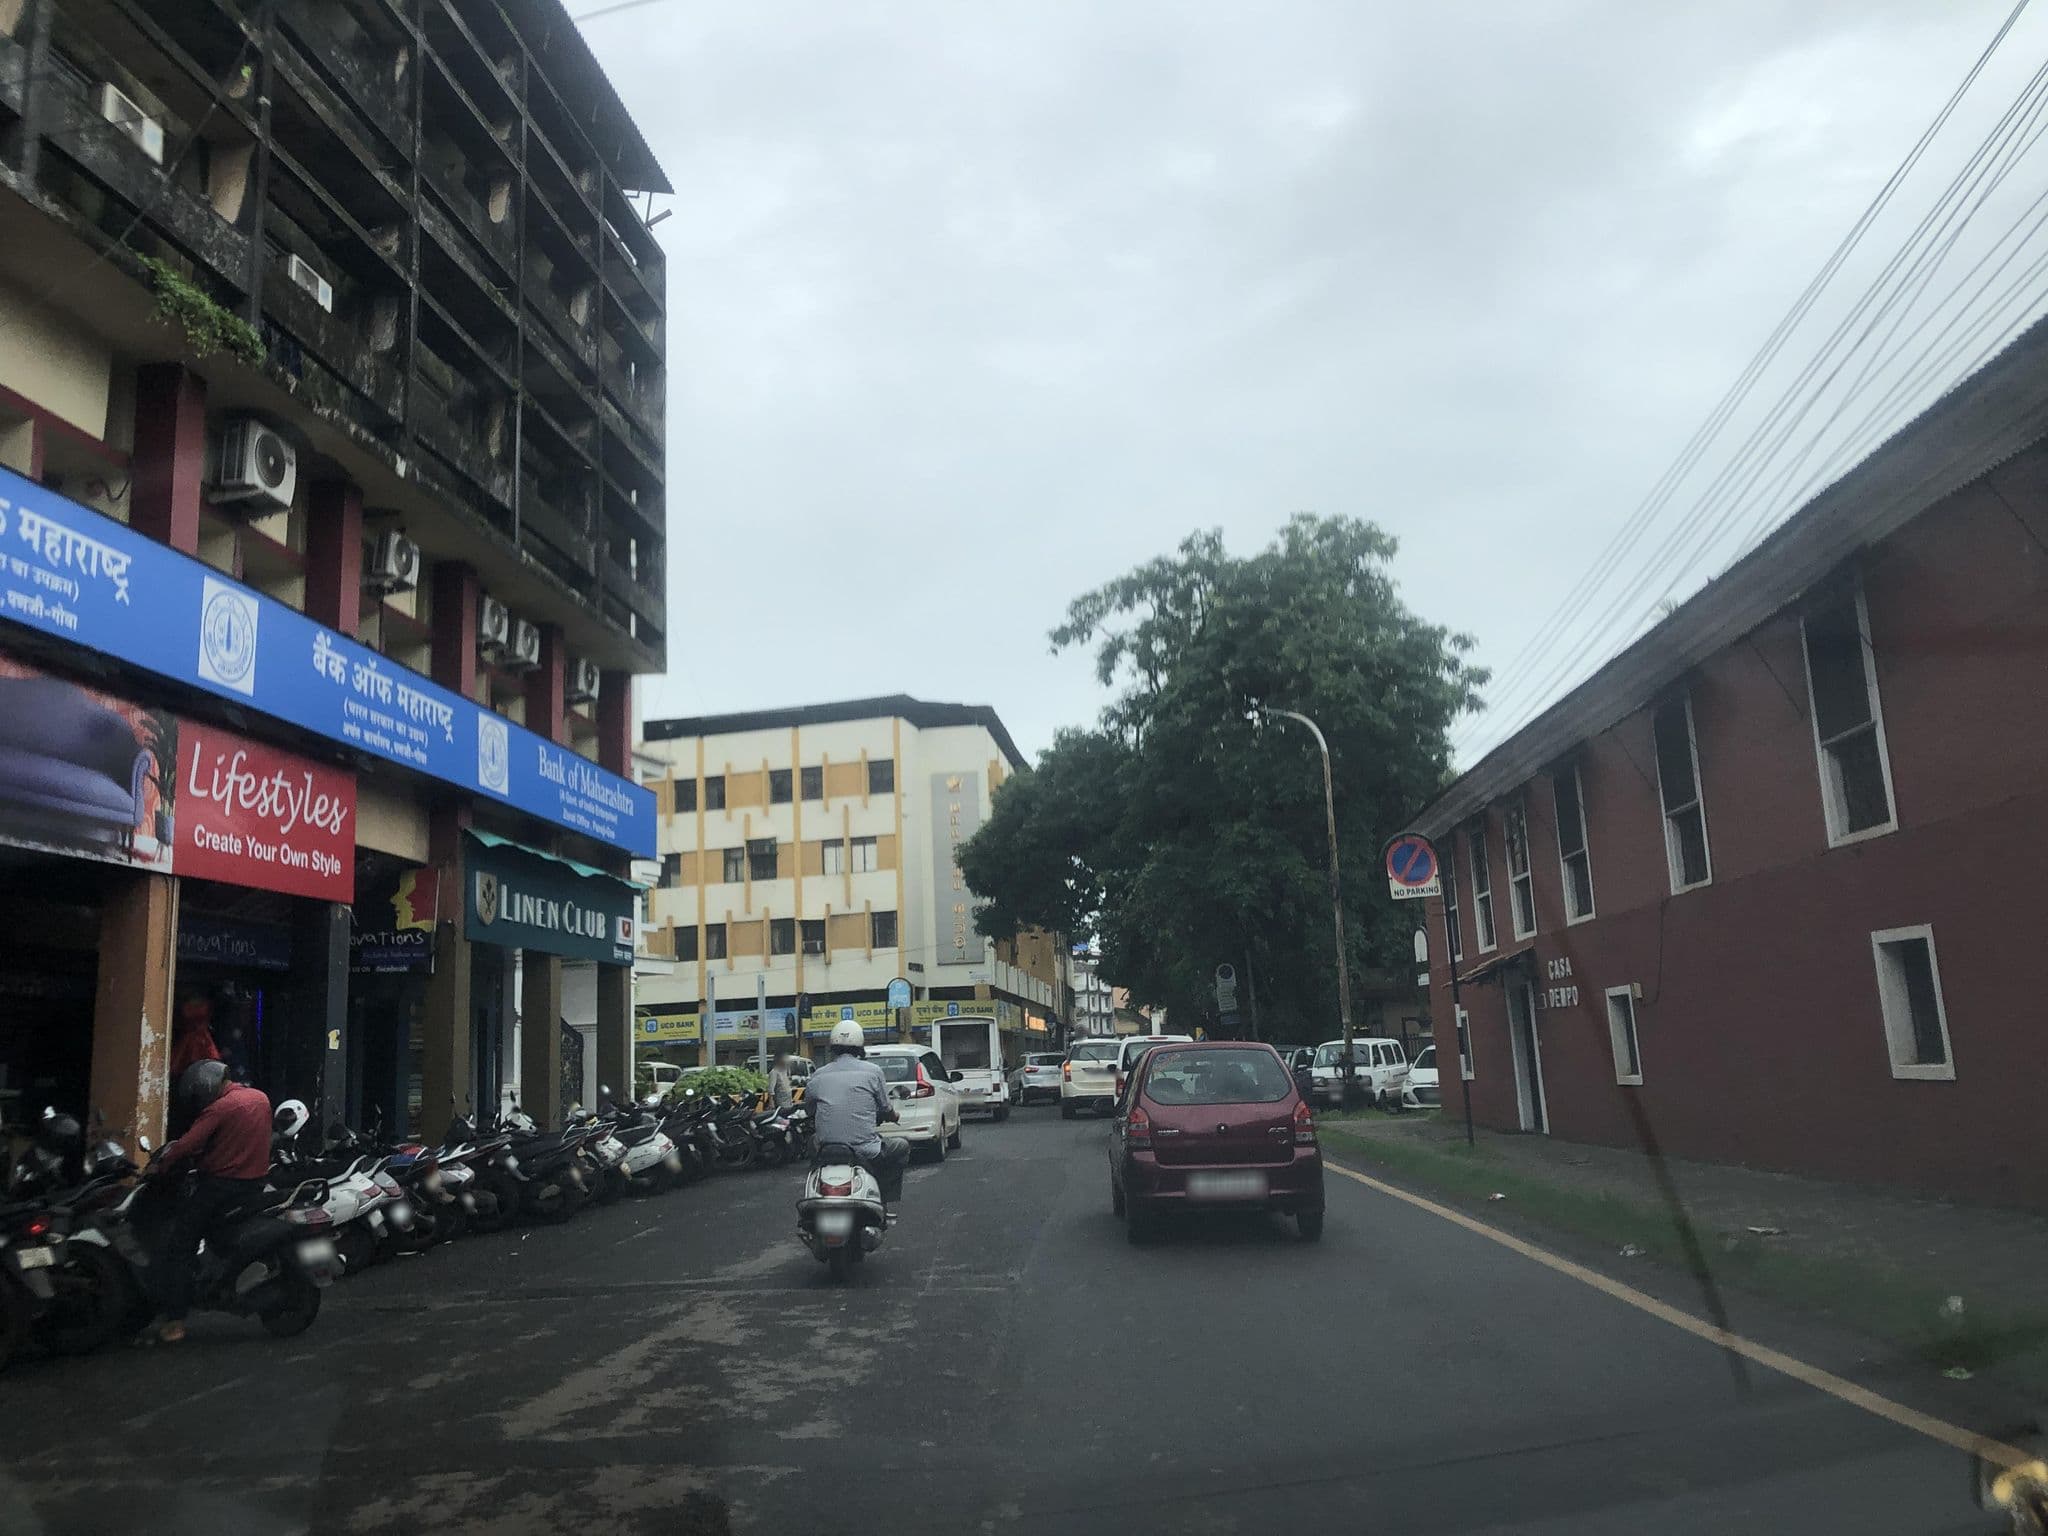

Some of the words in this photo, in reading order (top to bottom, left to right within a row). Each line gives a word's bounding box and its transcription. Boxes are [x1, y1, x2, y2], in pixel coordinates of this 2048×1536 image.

[18, 507, 132, 607] महाराष्ट्र
[313, 630, 348, 685] बैंक
[352, 656, 393, 705] ऑफ
[397, 683, 454, 744] महाराष्ट्र
[189, 741, 348, 835] Lifestyles
[538, 745, 566, 787] Bank
[568, 761, 579, 792] of
[580, 765, 634, 817] Maharashtra
[194, 823, 242, 855] Create
[246, 834, 278, 862] Your
[280, 843, 309, 869] Own
[312, 850, 341, 878] Style
[501, 884, 559, 930] LINEN
[563, 901, 606, 939] CLUB
[1394, 889, 1405, 897] NO
[1407, 886, 1439, 896] PARKING
[1548, 956, 1573, 980] CASA
[676, 1020, 695, 1028] BANK
